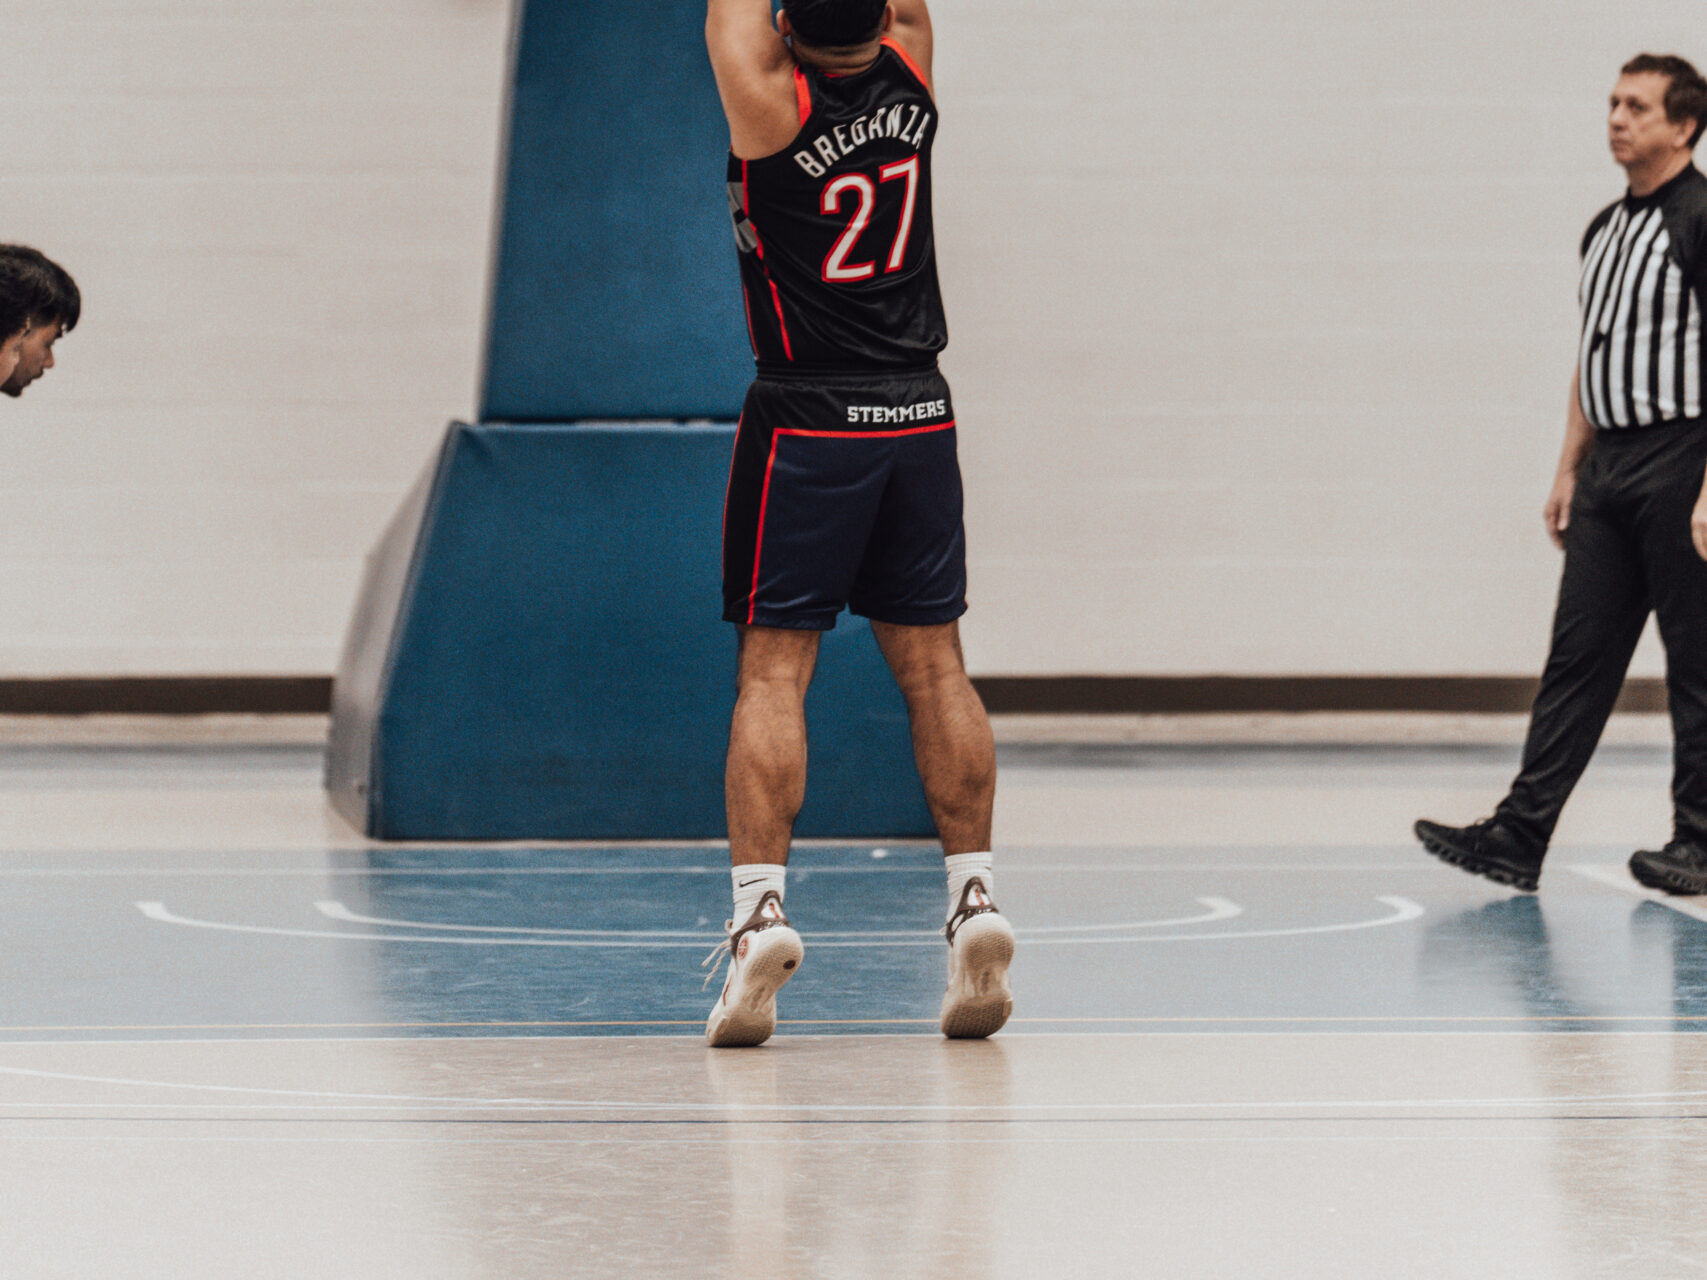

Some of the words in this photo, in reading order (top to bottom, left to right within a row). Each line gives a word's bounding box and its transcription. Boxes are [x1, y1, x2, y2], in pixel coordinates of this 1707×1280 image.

[793, 103, 931, 179] BREGANZA
[820, 153, 919, 283] 27
[847, 399, 946, 423] STEMMERS
